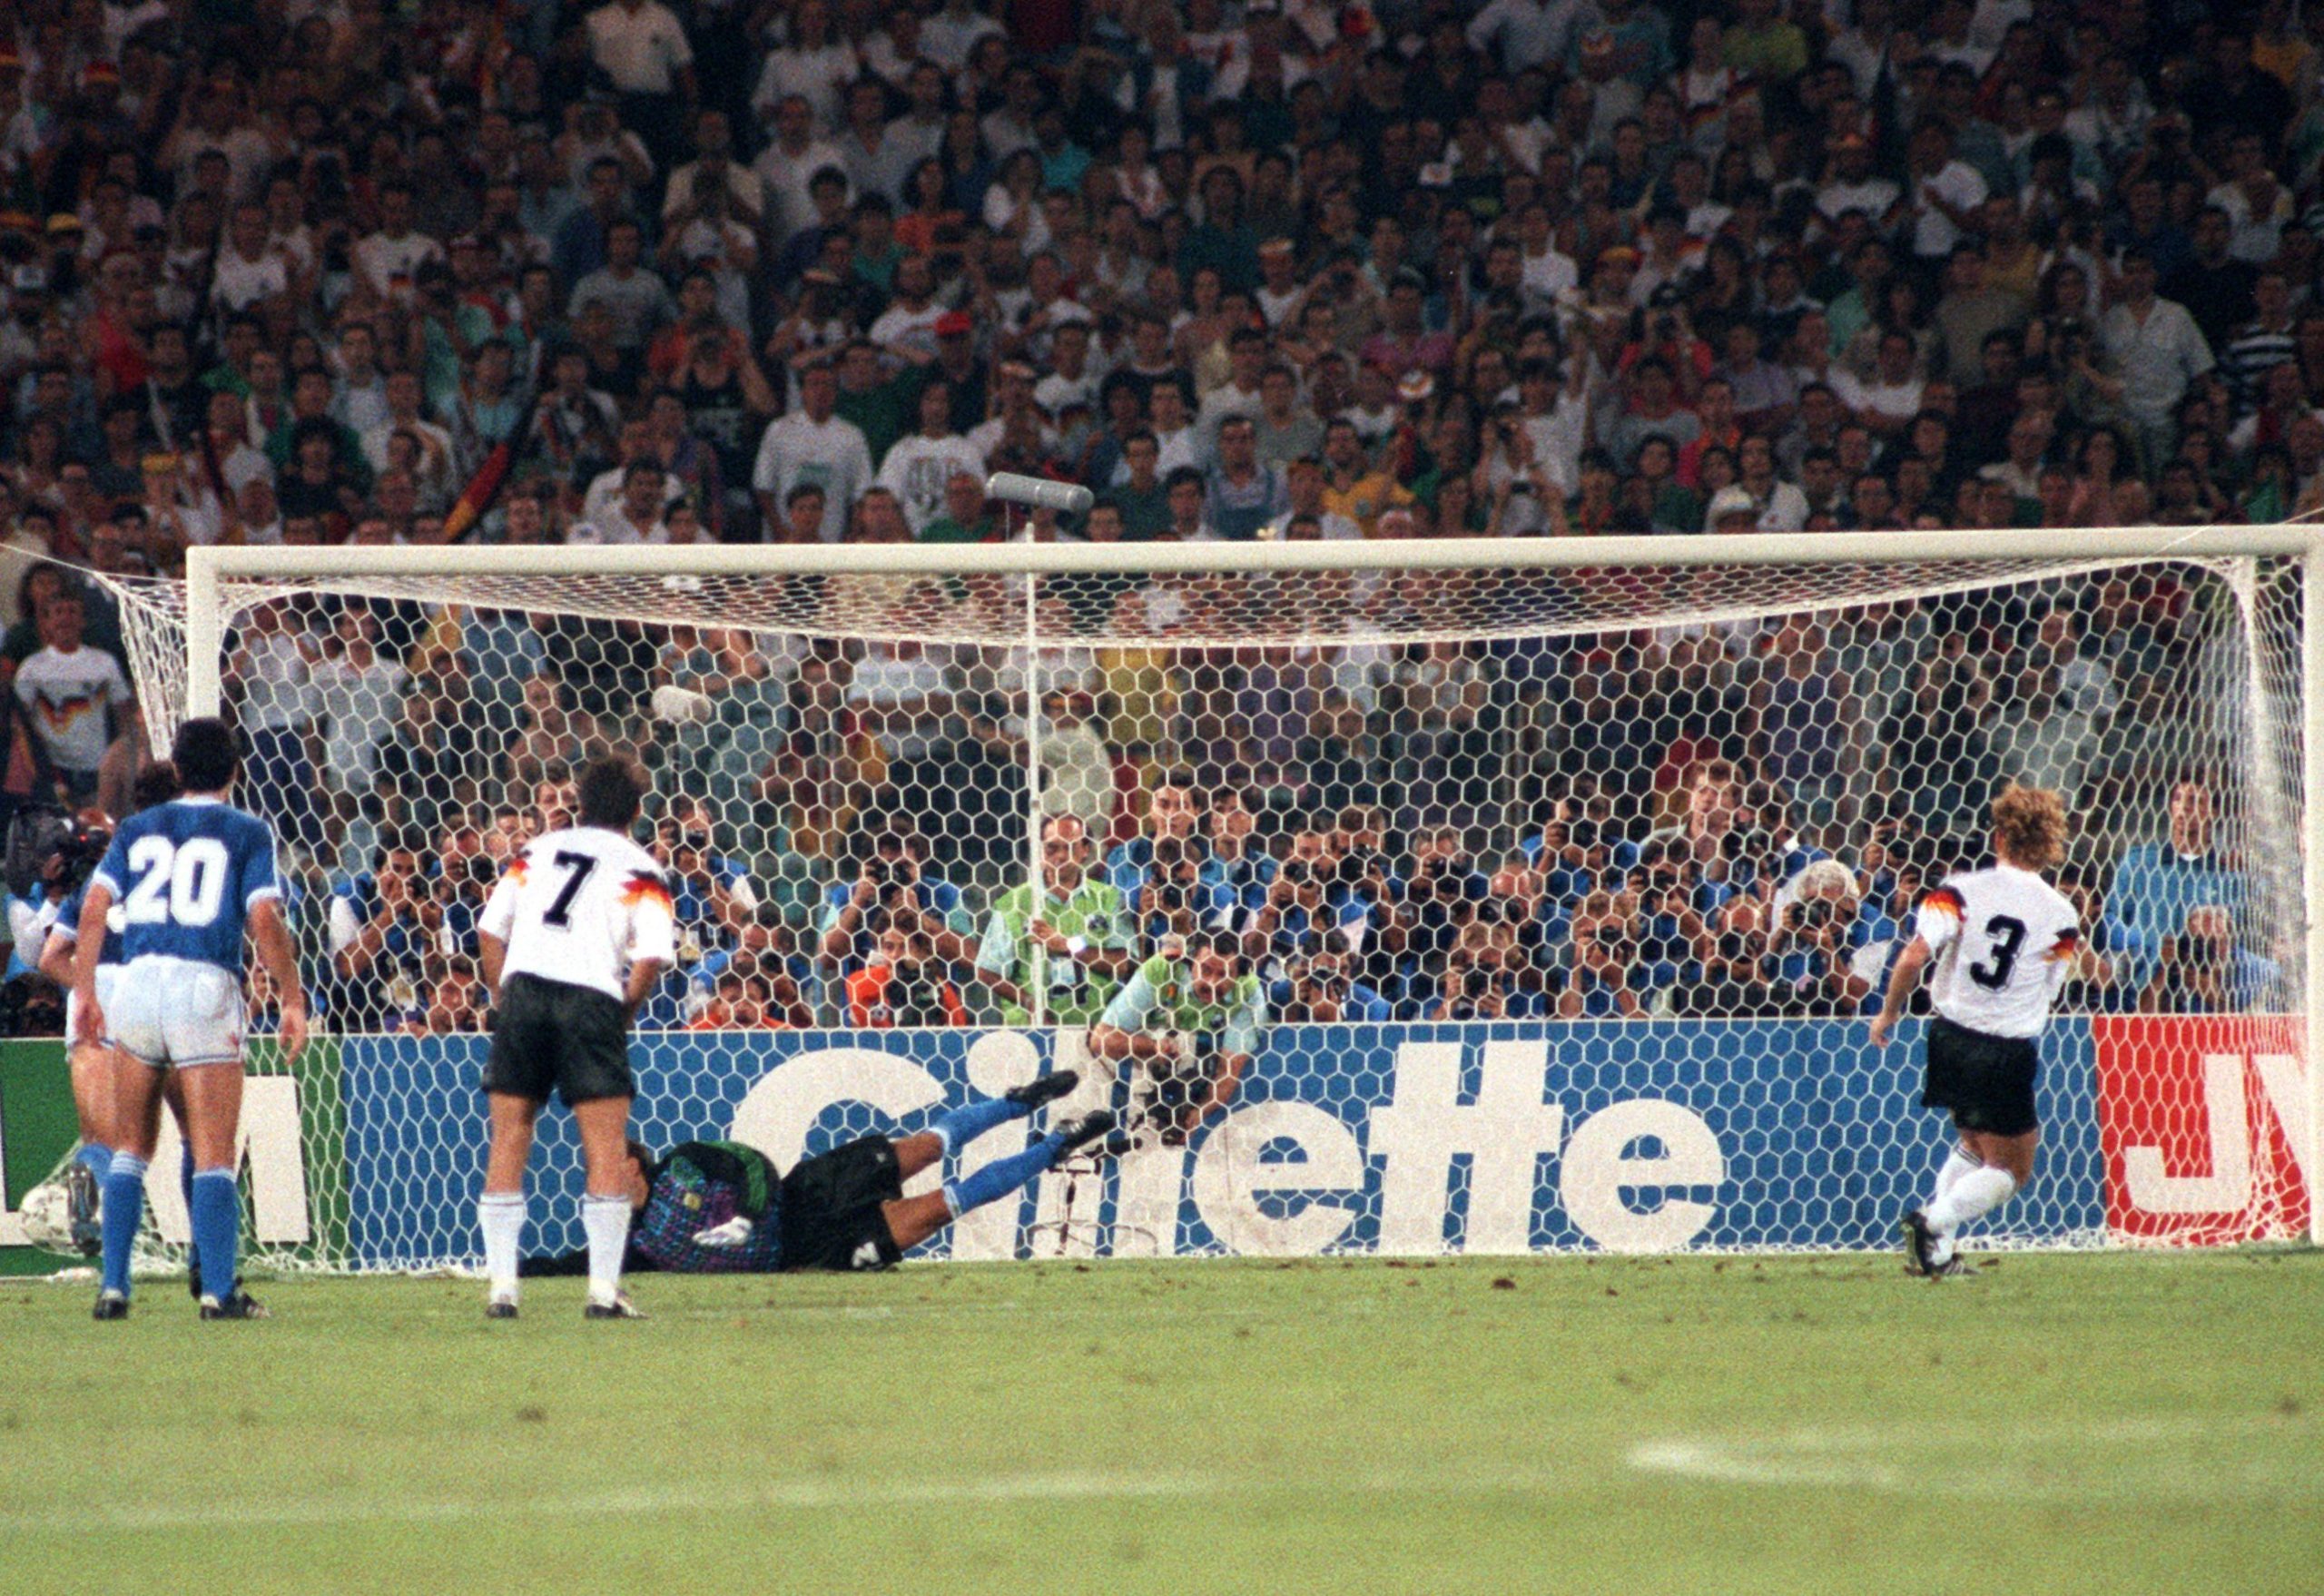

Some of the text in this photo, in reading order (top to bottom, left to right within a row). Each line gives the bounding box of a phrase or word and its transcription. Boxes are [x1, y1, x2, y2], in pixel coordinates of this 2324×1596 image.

[125, 835, 228, 927] 20
[543, 850, 600, 929] 7
[1970, 914, 2028, 992] 3
[728, 1030, 1724, 1257] Gillette
